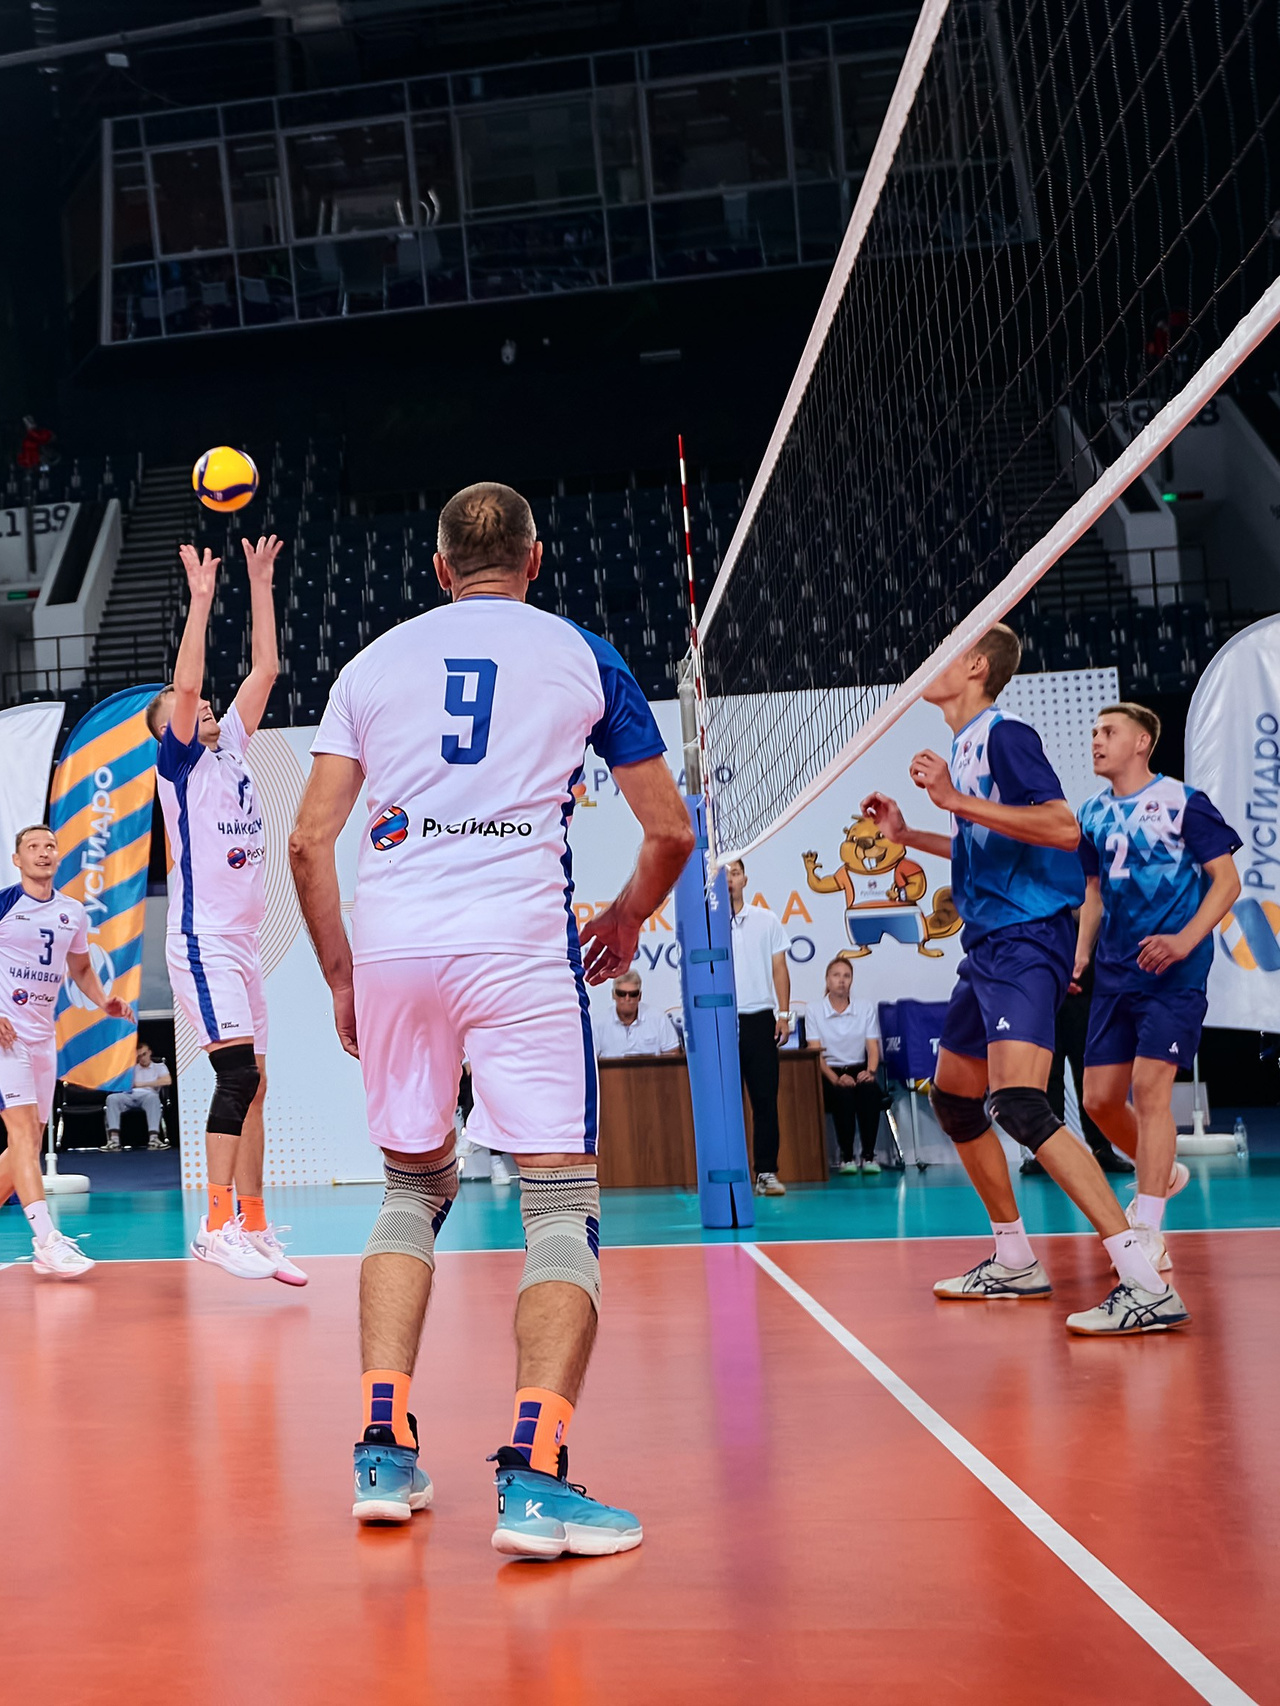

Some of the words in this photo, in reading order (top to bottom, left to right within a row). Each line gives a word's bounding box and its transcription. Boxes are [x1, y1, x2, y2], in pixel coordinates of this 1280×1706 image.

[440, 658, 499, 765] 9
[422, 817, 533, 838] РусГидро
[1105, 832, 1131, 880] 2
[38, 928, 55, 966] 3
